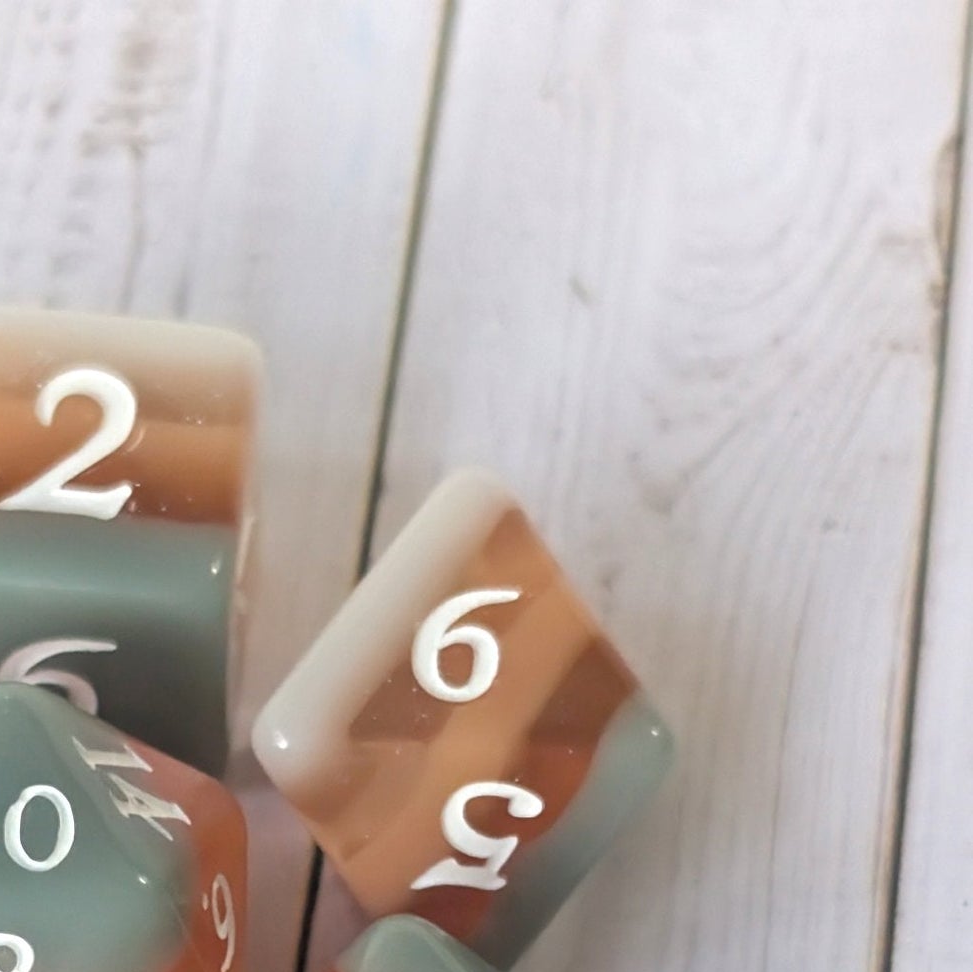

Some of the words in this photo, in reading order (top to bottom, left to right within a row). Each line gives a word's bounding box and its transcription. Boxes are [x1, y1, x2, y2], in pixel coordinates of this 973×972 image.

[410, 587, 520, 702] 6
[72, 735, 192, 842] 14
[409, 781, 545, 892] 5
